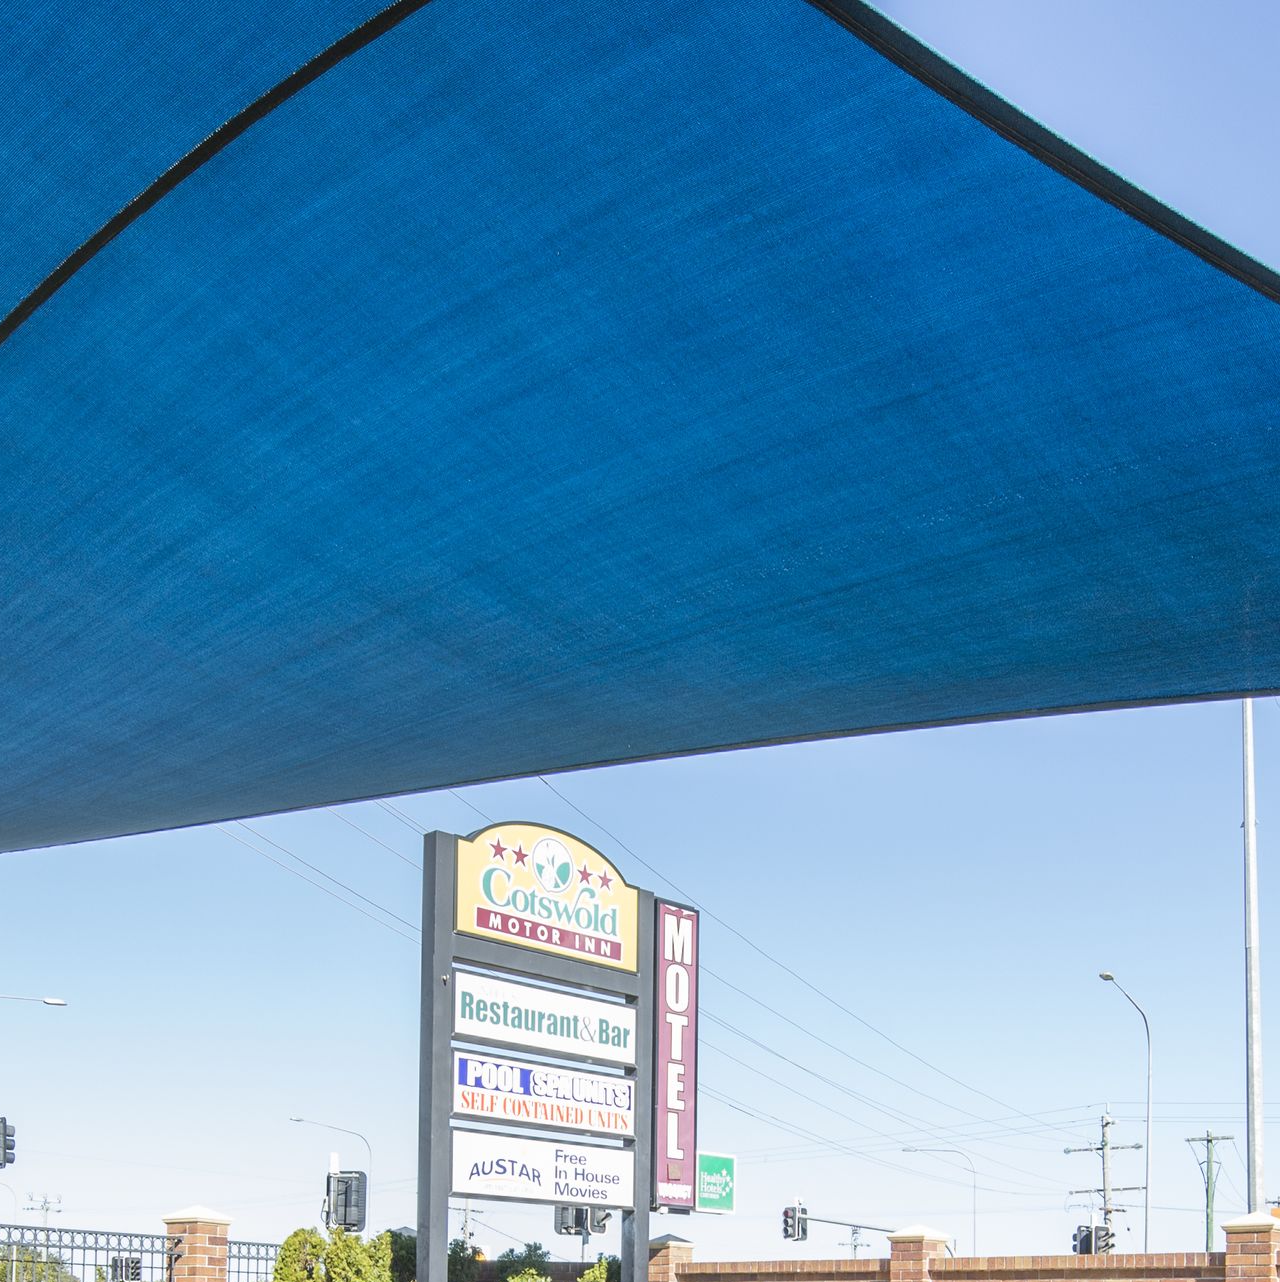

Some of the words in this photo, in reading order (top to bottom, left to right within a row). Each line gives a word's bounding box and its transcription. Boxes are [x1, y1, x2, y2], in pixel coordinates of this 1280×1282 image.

[482, 867, 618, 937] Cotswold
[488, 912, 561, 945] MOTOR
[575, 935, 611, 957] INN
[663, 912, 693, 1160] MOTEL
[466, 1059, 524, 1094] POOL
[461, 1090, 499, 1113] SELF
[502, 1096, 584, 1125] CONTAINED
[588, 1109, 629, 1131] UNITS
[468, 1158, 542, 1187] AUSTAR
[554, 1149, 587, 1166] Free
[554, 1165, 568, 1180] In
[574, 1168, 620, 1185] House
[554, 1182, 608, 1200] Movies
